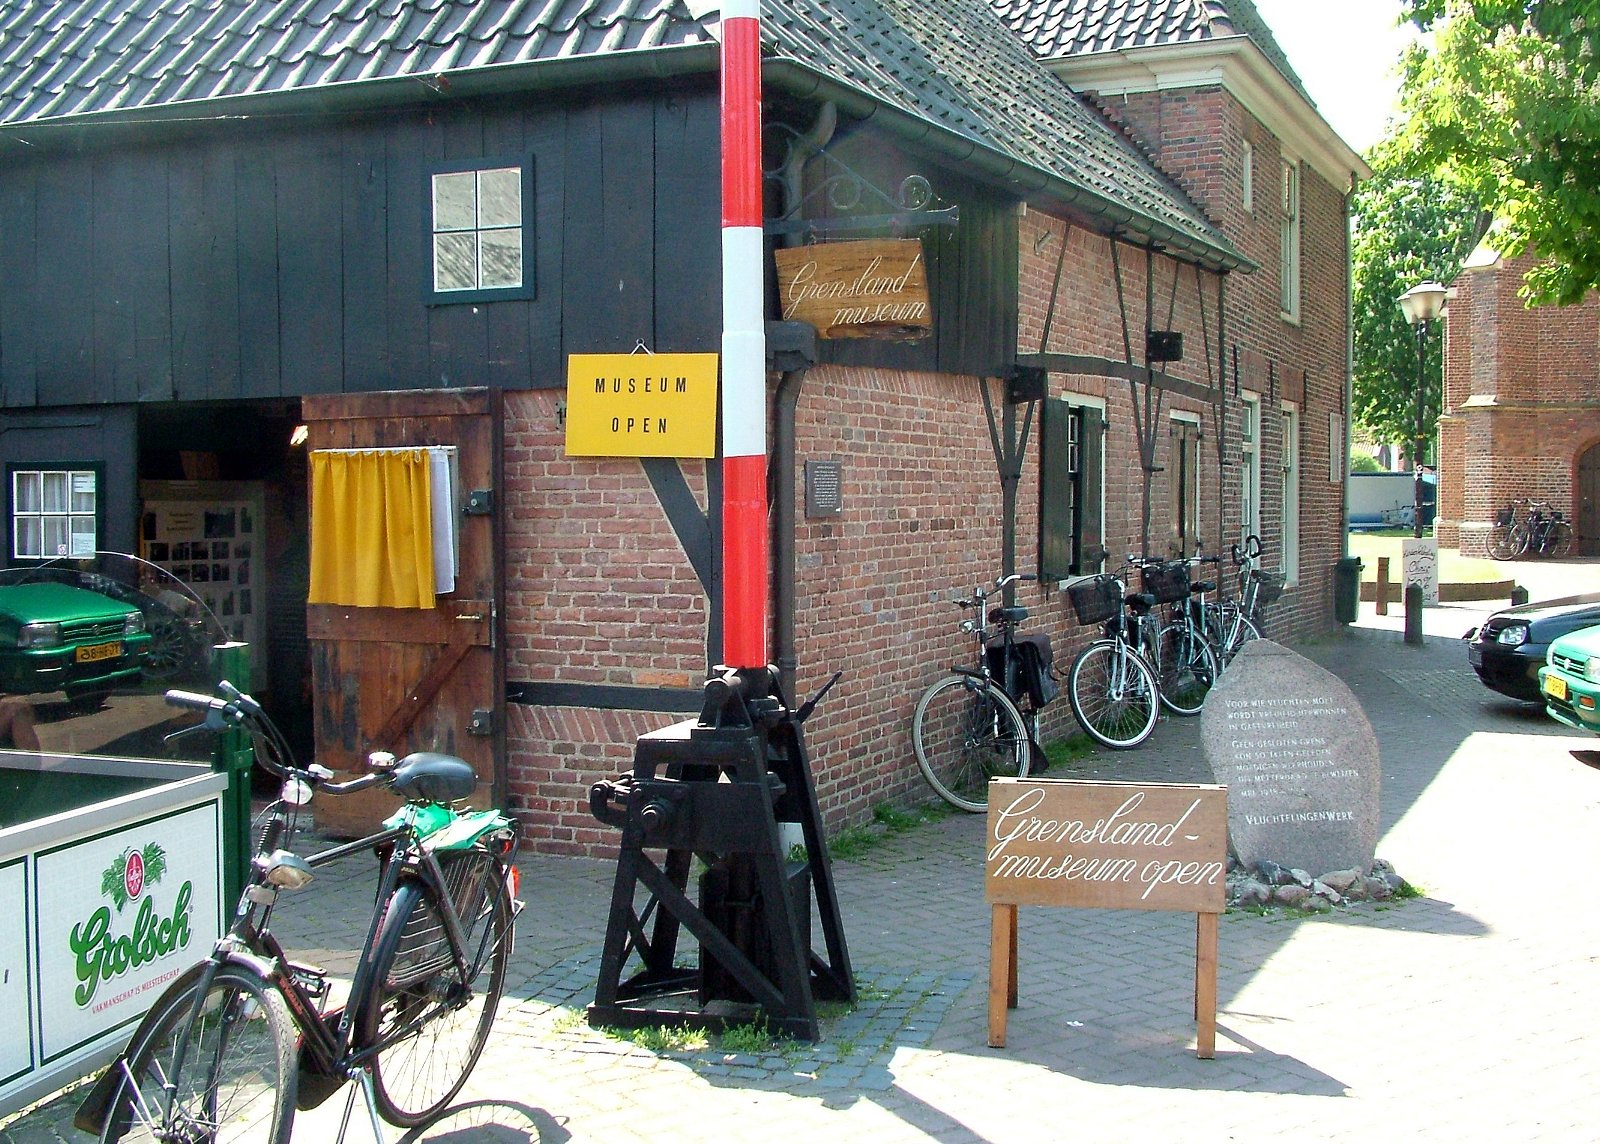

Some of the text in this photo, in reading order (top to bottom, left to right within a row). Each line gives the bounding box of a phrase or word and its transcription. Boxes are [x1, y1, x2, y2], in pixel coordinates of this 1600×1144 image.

[831, 301, 926, 325] museum
[595, 377, 687, 393] MUSEUM
[611, 417, 667, 434] OPEN
[992, 854, 1223, 900] museum open
[70, 880, 192, 1006] Grolsch
[92, 967, 180, 1014] VAKMANSCHAP IS MEESTERSCHAP
